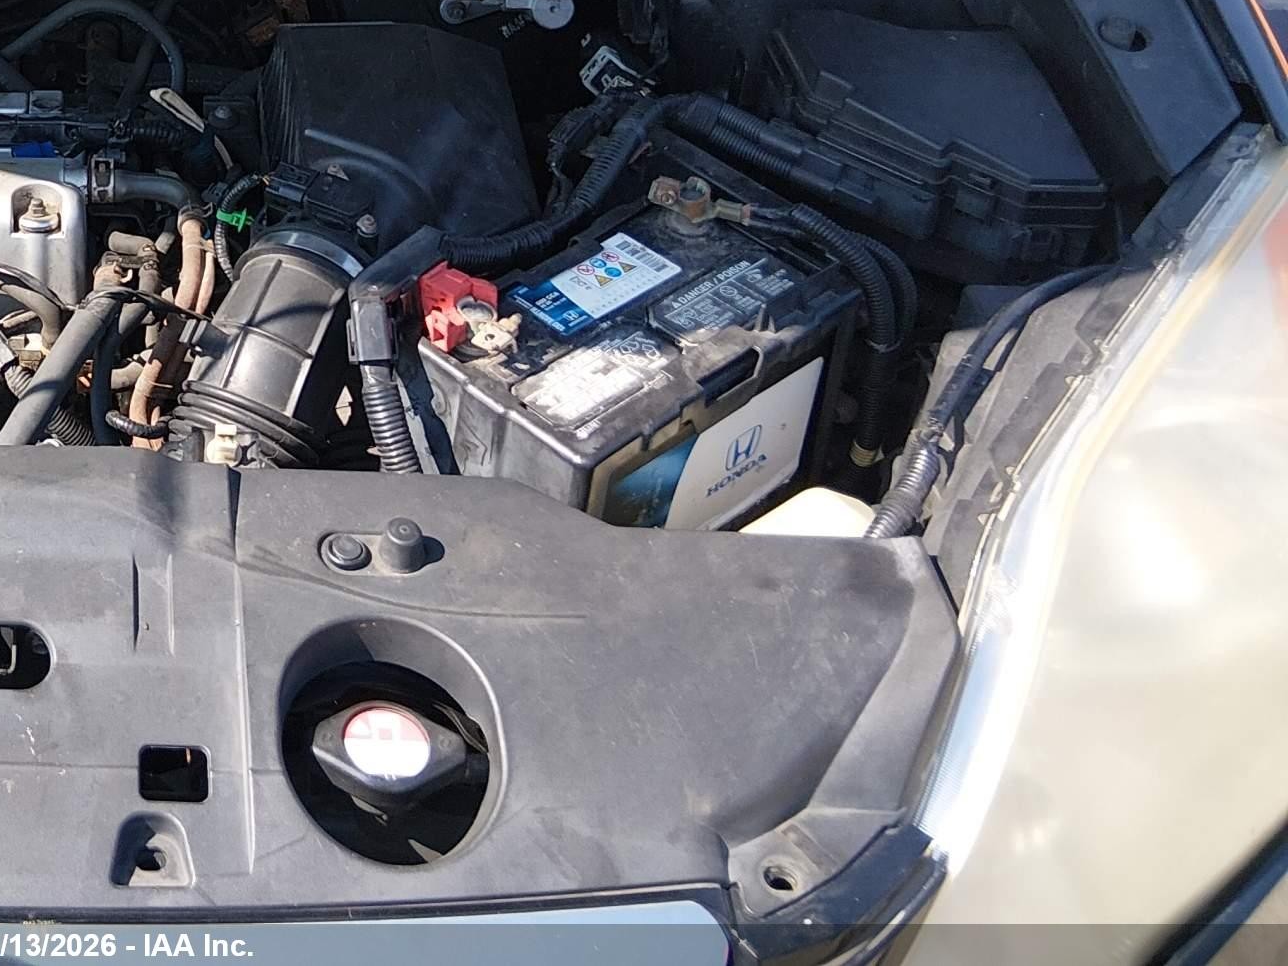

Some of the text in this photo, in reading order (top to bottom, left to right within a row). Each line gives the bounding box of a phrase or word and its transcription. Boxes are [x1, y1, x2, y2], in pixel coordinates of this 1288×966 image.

[677, 280, 715, 305] DANGER
[717, 260, 751, 280] POISON
[706, 453, 767, 498] HONDA
